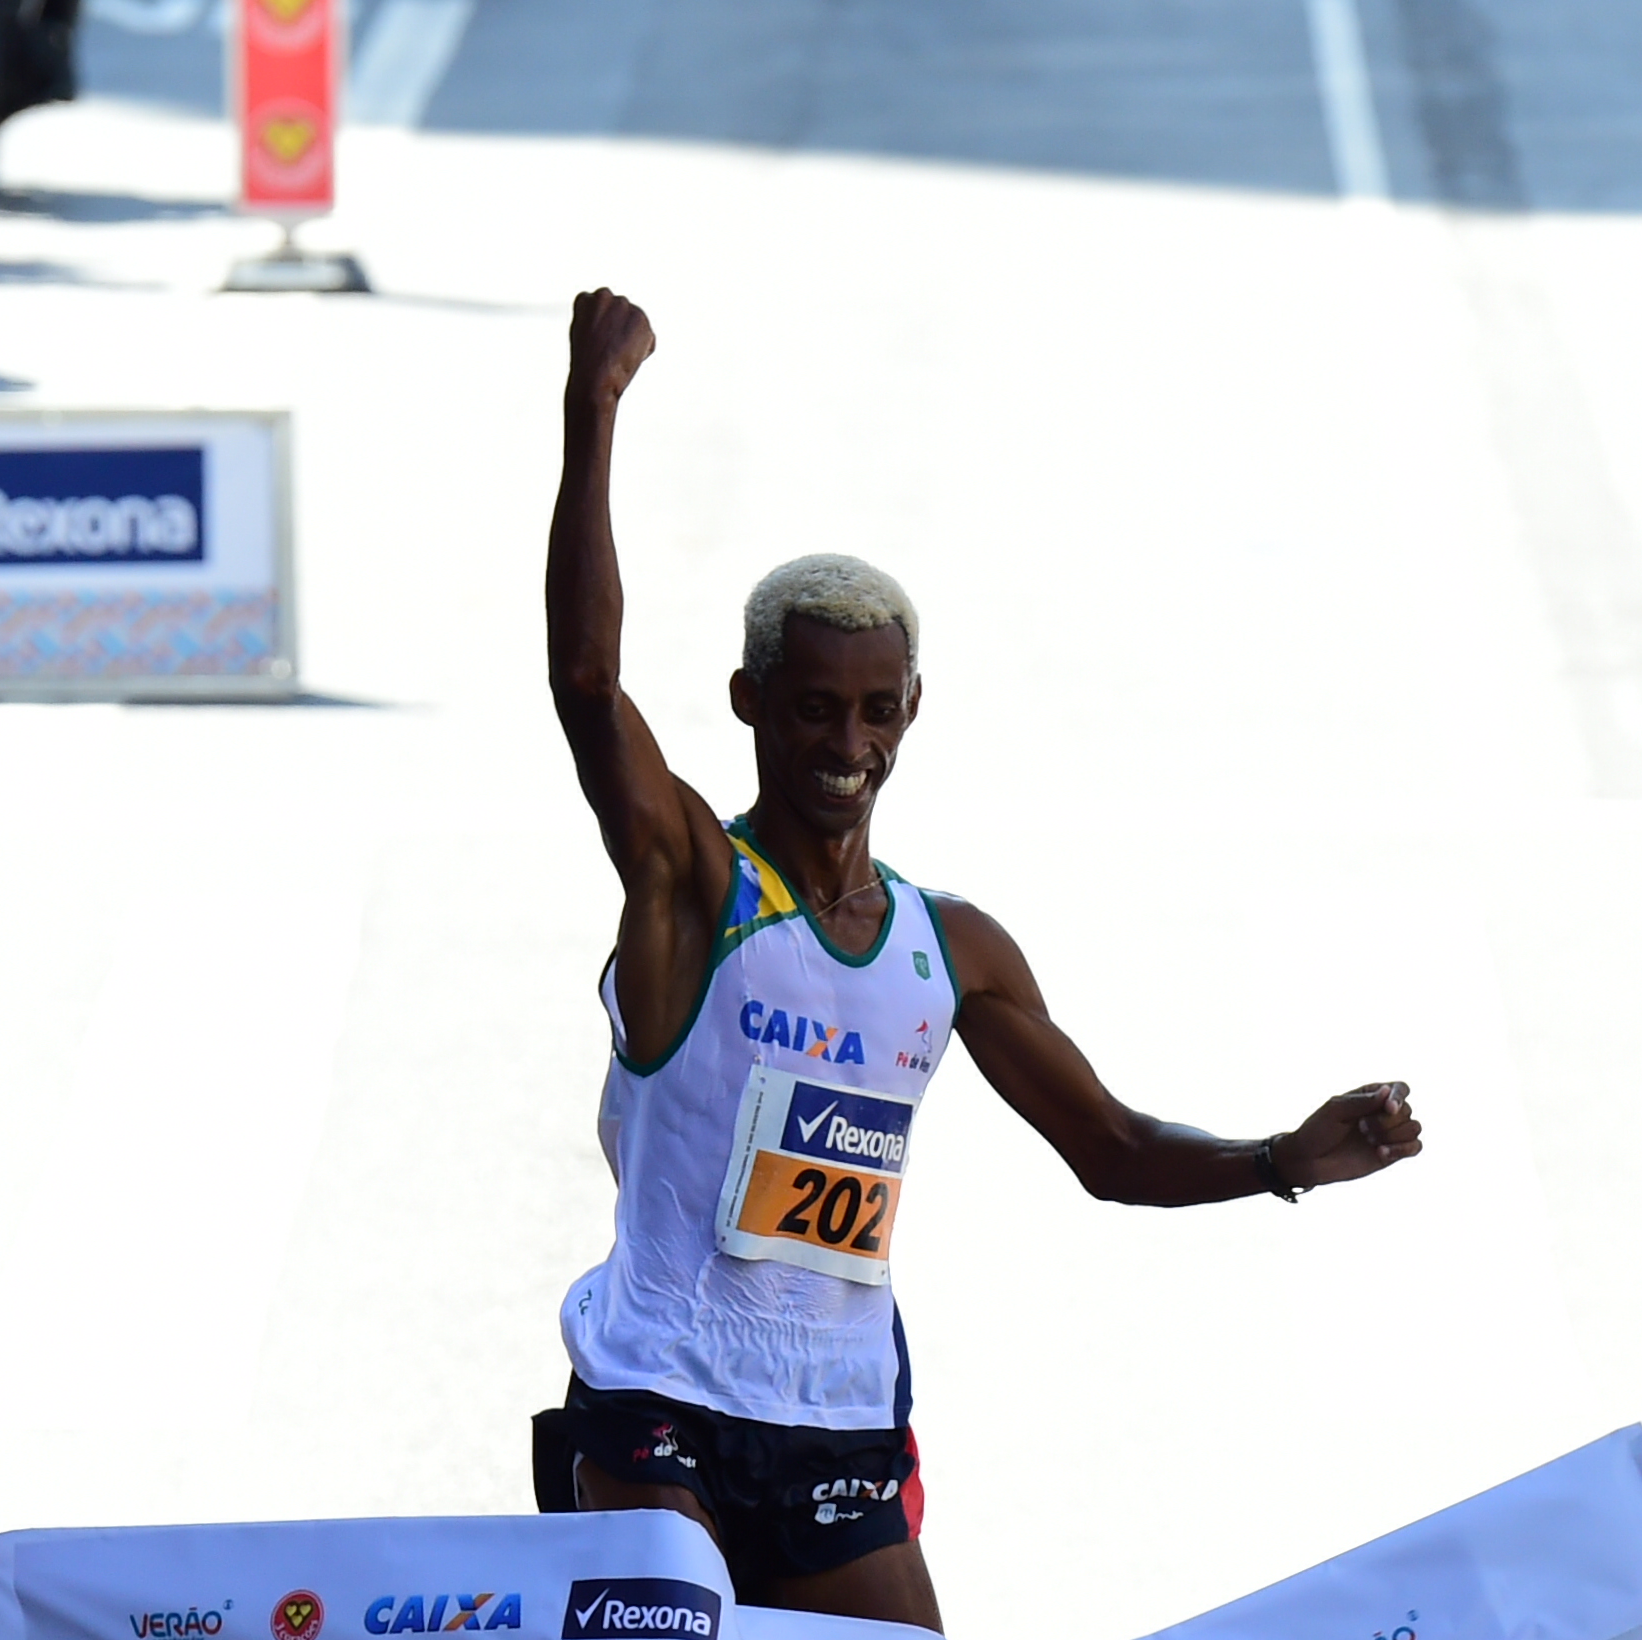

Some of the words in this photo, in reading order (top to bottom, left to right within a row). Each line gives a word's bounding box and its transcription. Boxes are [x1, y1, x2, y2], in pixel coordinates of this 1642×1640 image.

[739, 999, 866, 1065] CAIXA
[825, 1115, 905, 1162] Rexona
[775, 1168, 889, 1253] 202
[130, 1606, 222, 1638] VERÃO
[363, 1592, 522, 1635] CAIXA
[602, 1599, 712, 1636] Rexona
